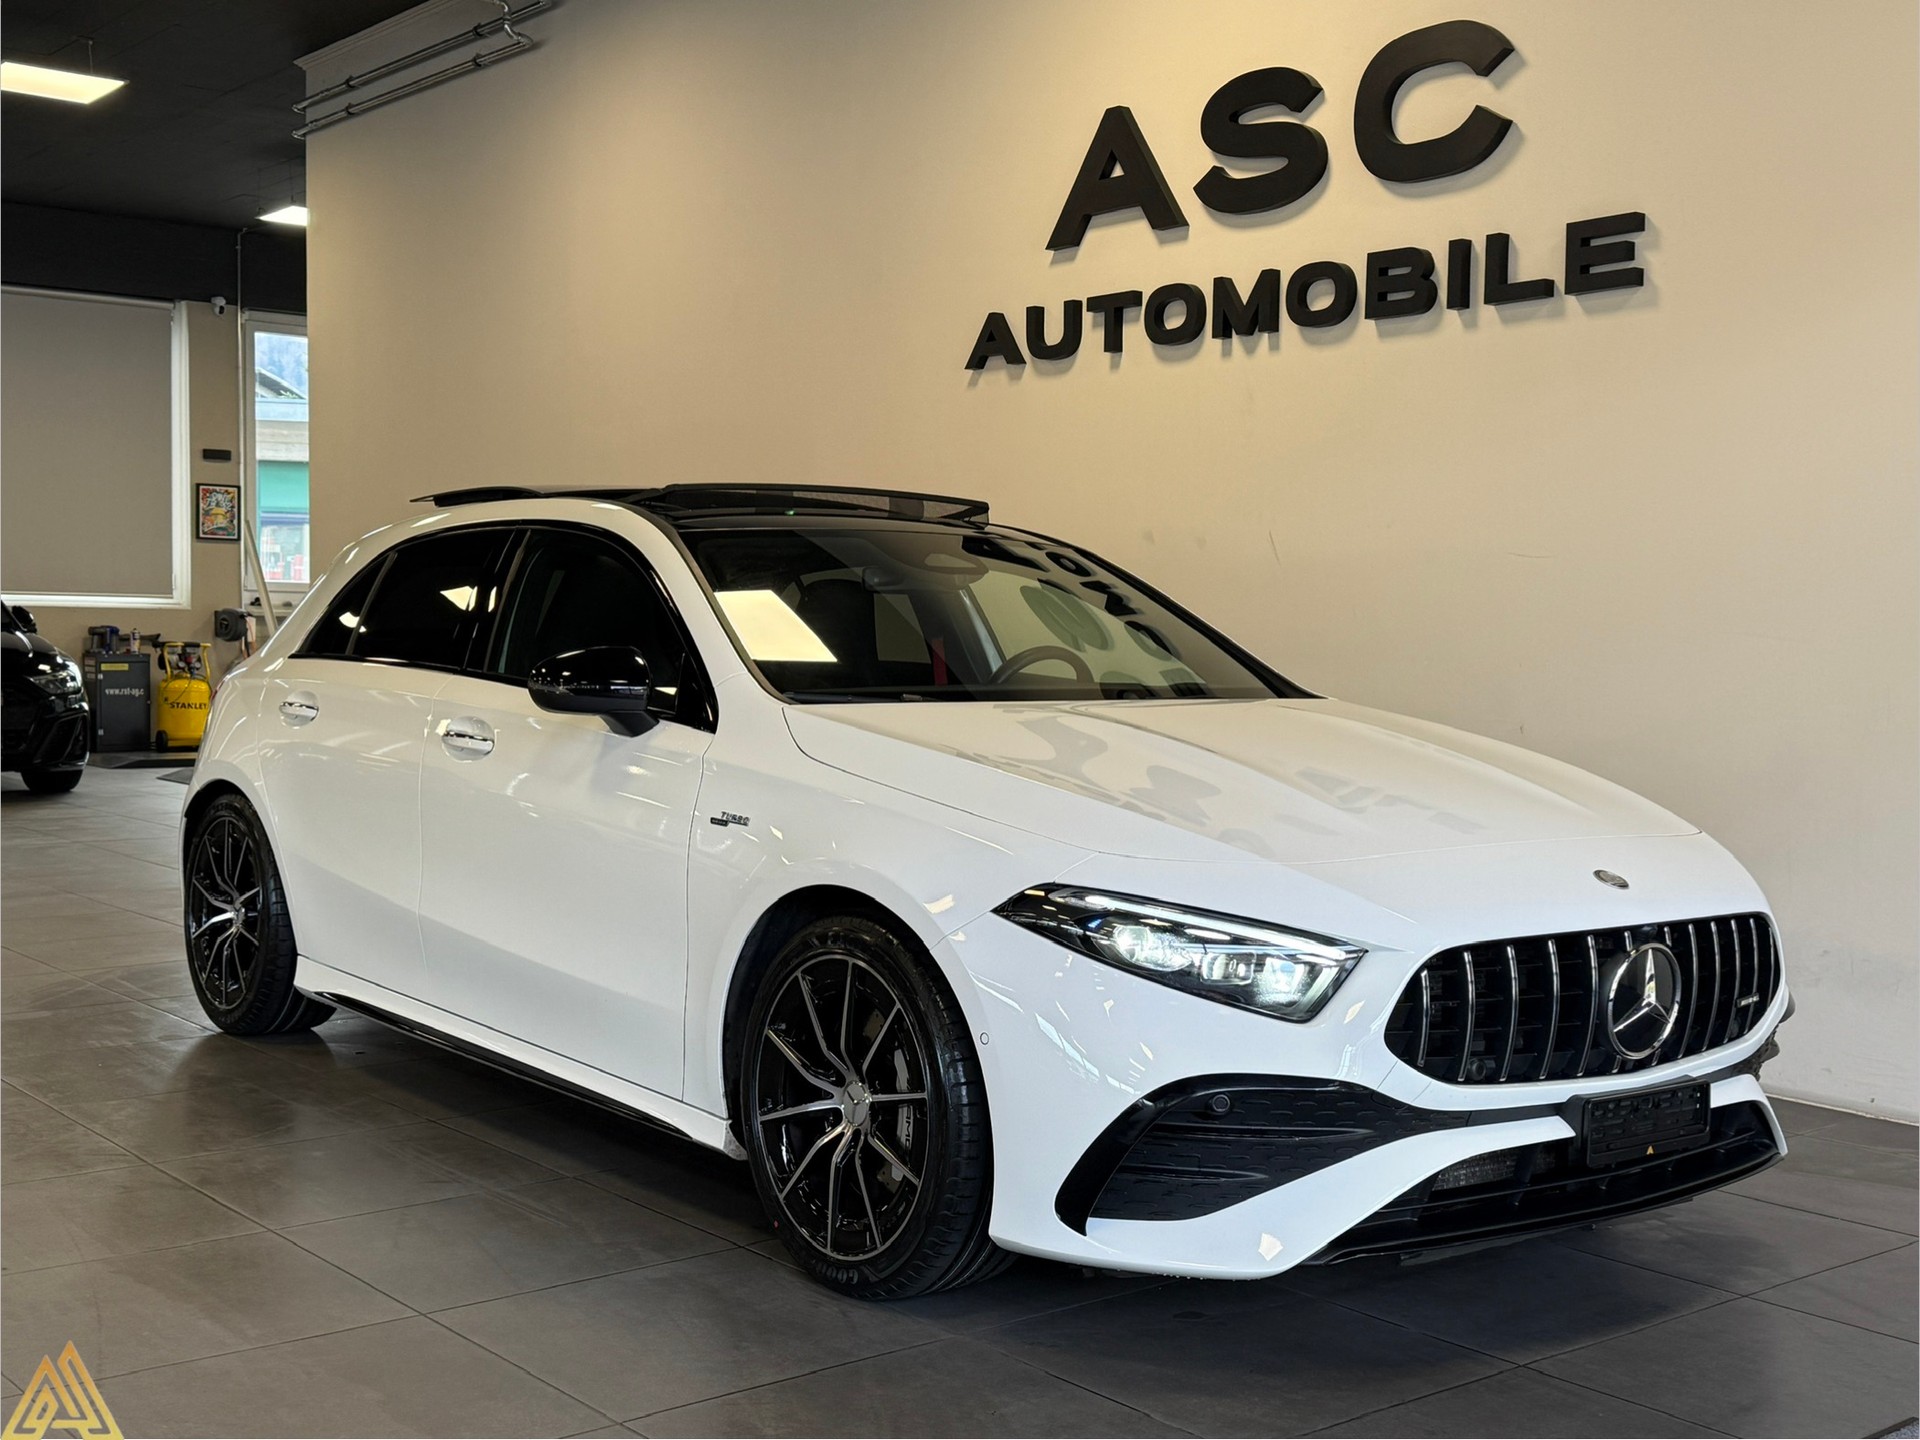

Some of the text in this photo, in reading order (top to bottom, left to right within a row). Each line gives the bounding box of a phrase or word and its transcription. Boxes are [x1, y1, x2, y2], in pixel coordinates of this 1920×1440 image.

[1045, 19, 1516, 252] ASC
[965, 212, 1646, 371] AUTOMOBILE
[169, 701, 208, 710] STANLEY
[720, 811, 750, 824] TURBO
